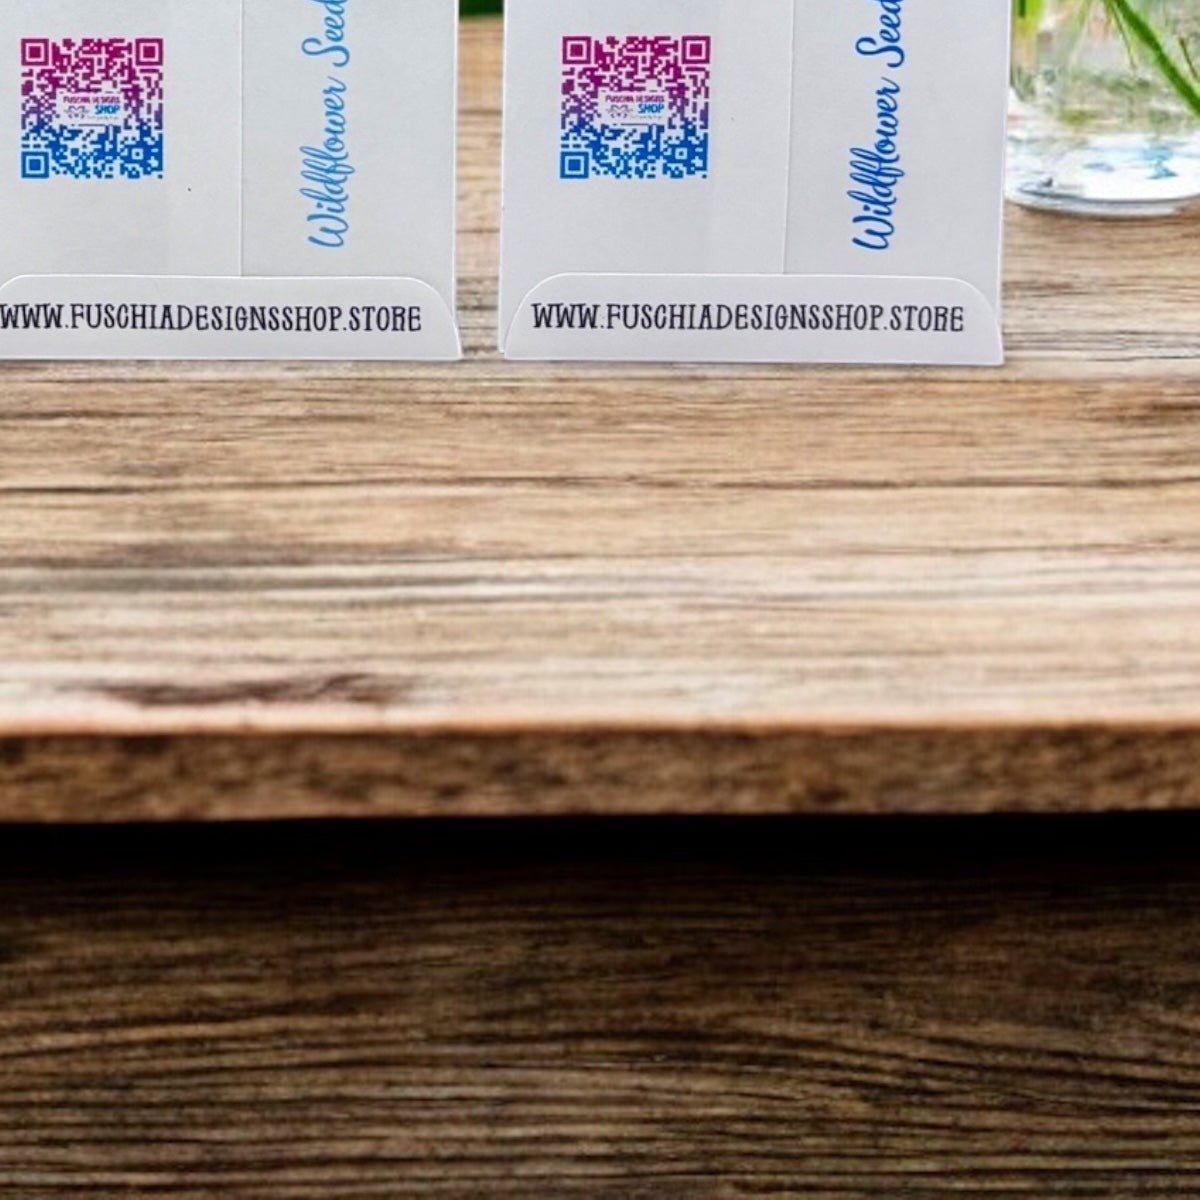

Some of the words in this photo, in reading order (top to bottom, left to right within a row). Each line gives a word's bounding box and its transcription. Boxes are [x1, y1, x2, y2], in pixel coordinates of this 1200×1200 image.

[95, 104, 120, 115] SHOP
[638, 103, 664, 114] SHOP
[299, 76, 355, 249] Wildflower
[846, 77, 906, 252] Wildflower
[531, 303, 964, 332] WWW.FUSCHIADESIGNSSHOP.STORE
